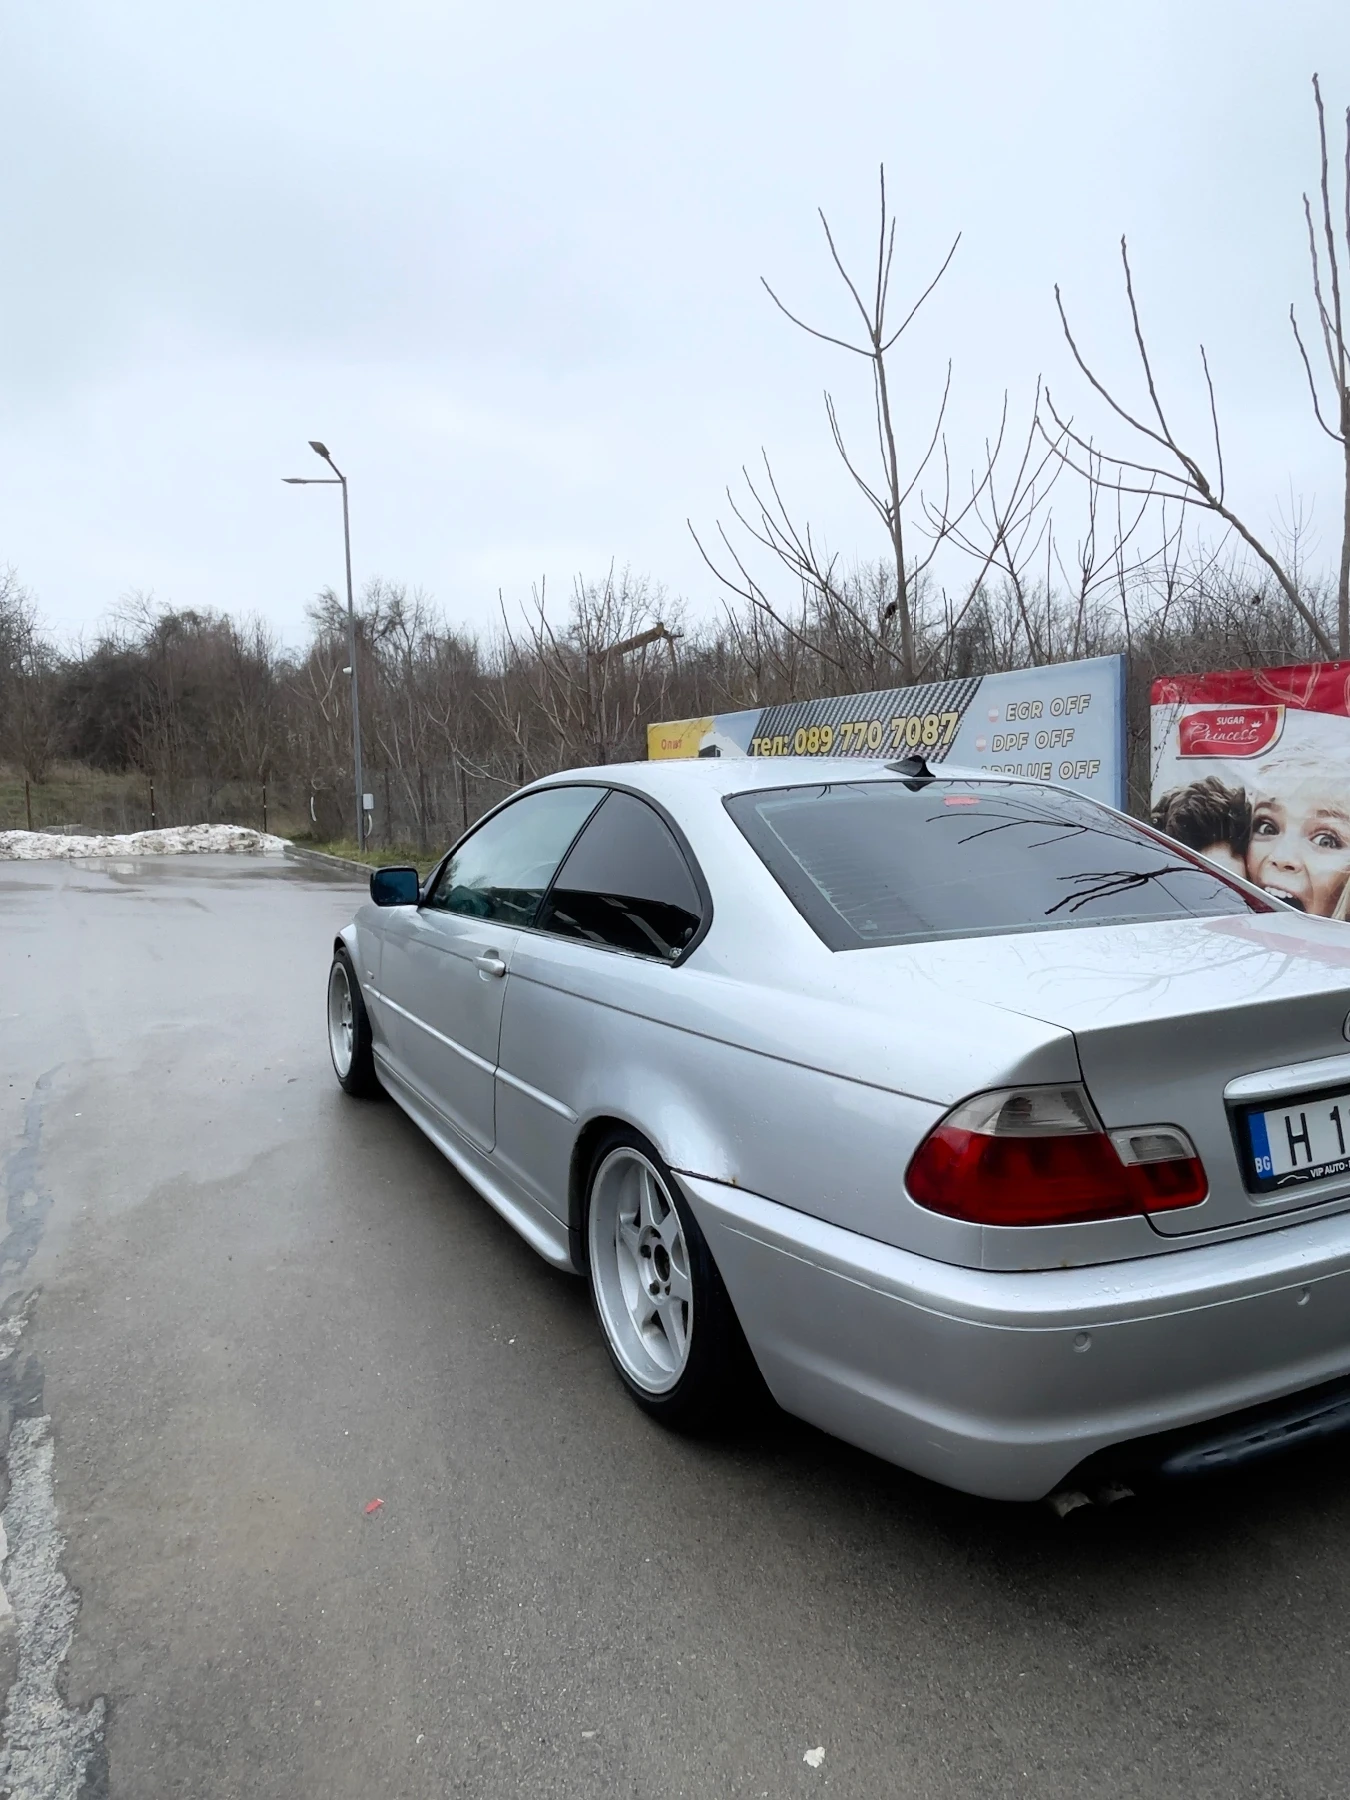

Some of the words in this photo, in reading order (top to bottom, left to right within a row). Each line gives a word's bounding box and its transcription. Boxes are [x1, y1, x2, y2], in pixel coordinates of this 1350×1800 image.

[1006, 700, 1043, 721] EGR
[1050, 694, 1091, 716] OFF
[1216, 716, 1245, 725] SUGAR
[751, 735, 790, 756] тел:
[794, 725, 834, 754] 089
[839, 719, 884, 750] 770
[890, 711, 960, 748] 7087
[992, 732, 1029, 752] DPF
[1035, 728, 1075, 749] OFF
[1059, 760, 1100, 780] OFF
[1284, 1112, 1313, 1166] H
[1329, 1105, 1350, 1155] 1
[1255, 1155, 1271, 1173] BG
[1310, 1167, 1324, 1178] VIP
